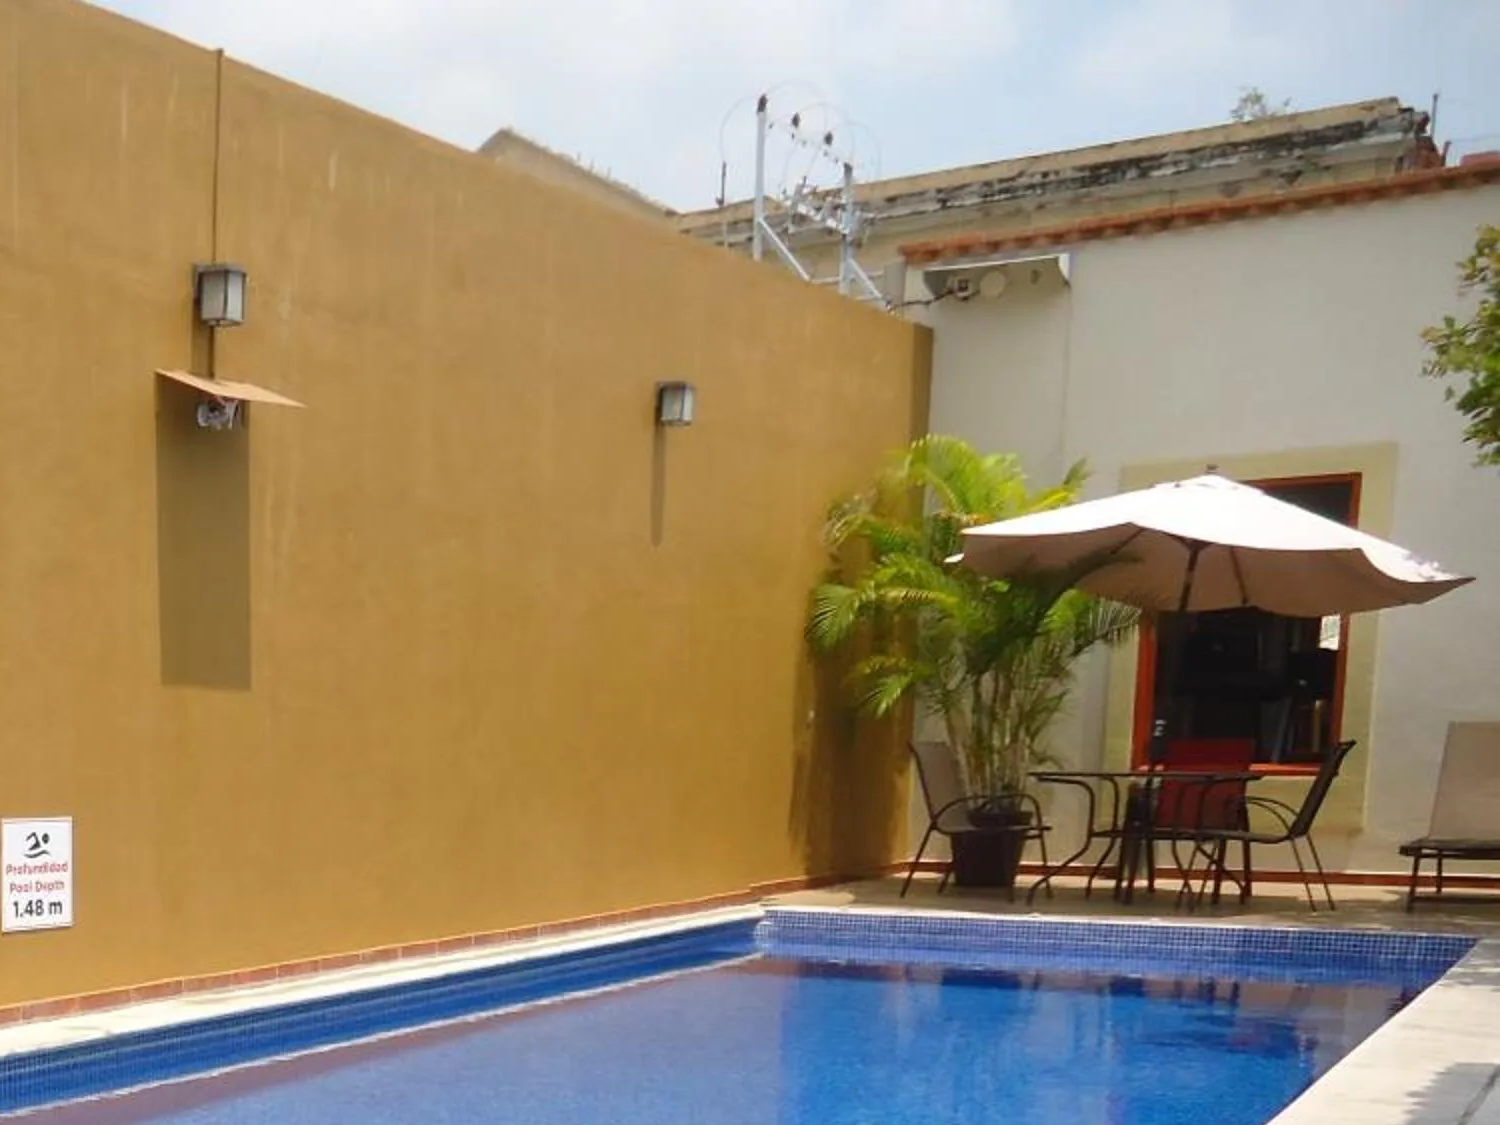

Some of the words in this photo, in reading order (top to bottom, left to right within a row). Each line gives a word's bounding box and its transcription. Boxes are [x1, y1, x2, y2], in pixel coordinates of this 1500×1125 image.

[6, 862, 69, 876] Profundidad
[9, 881, 33, 894] Pool
[35, 880, 65, 893] Depth
[13, 899, 45, 918] 1.48
[49, 901, 63, 915] m
